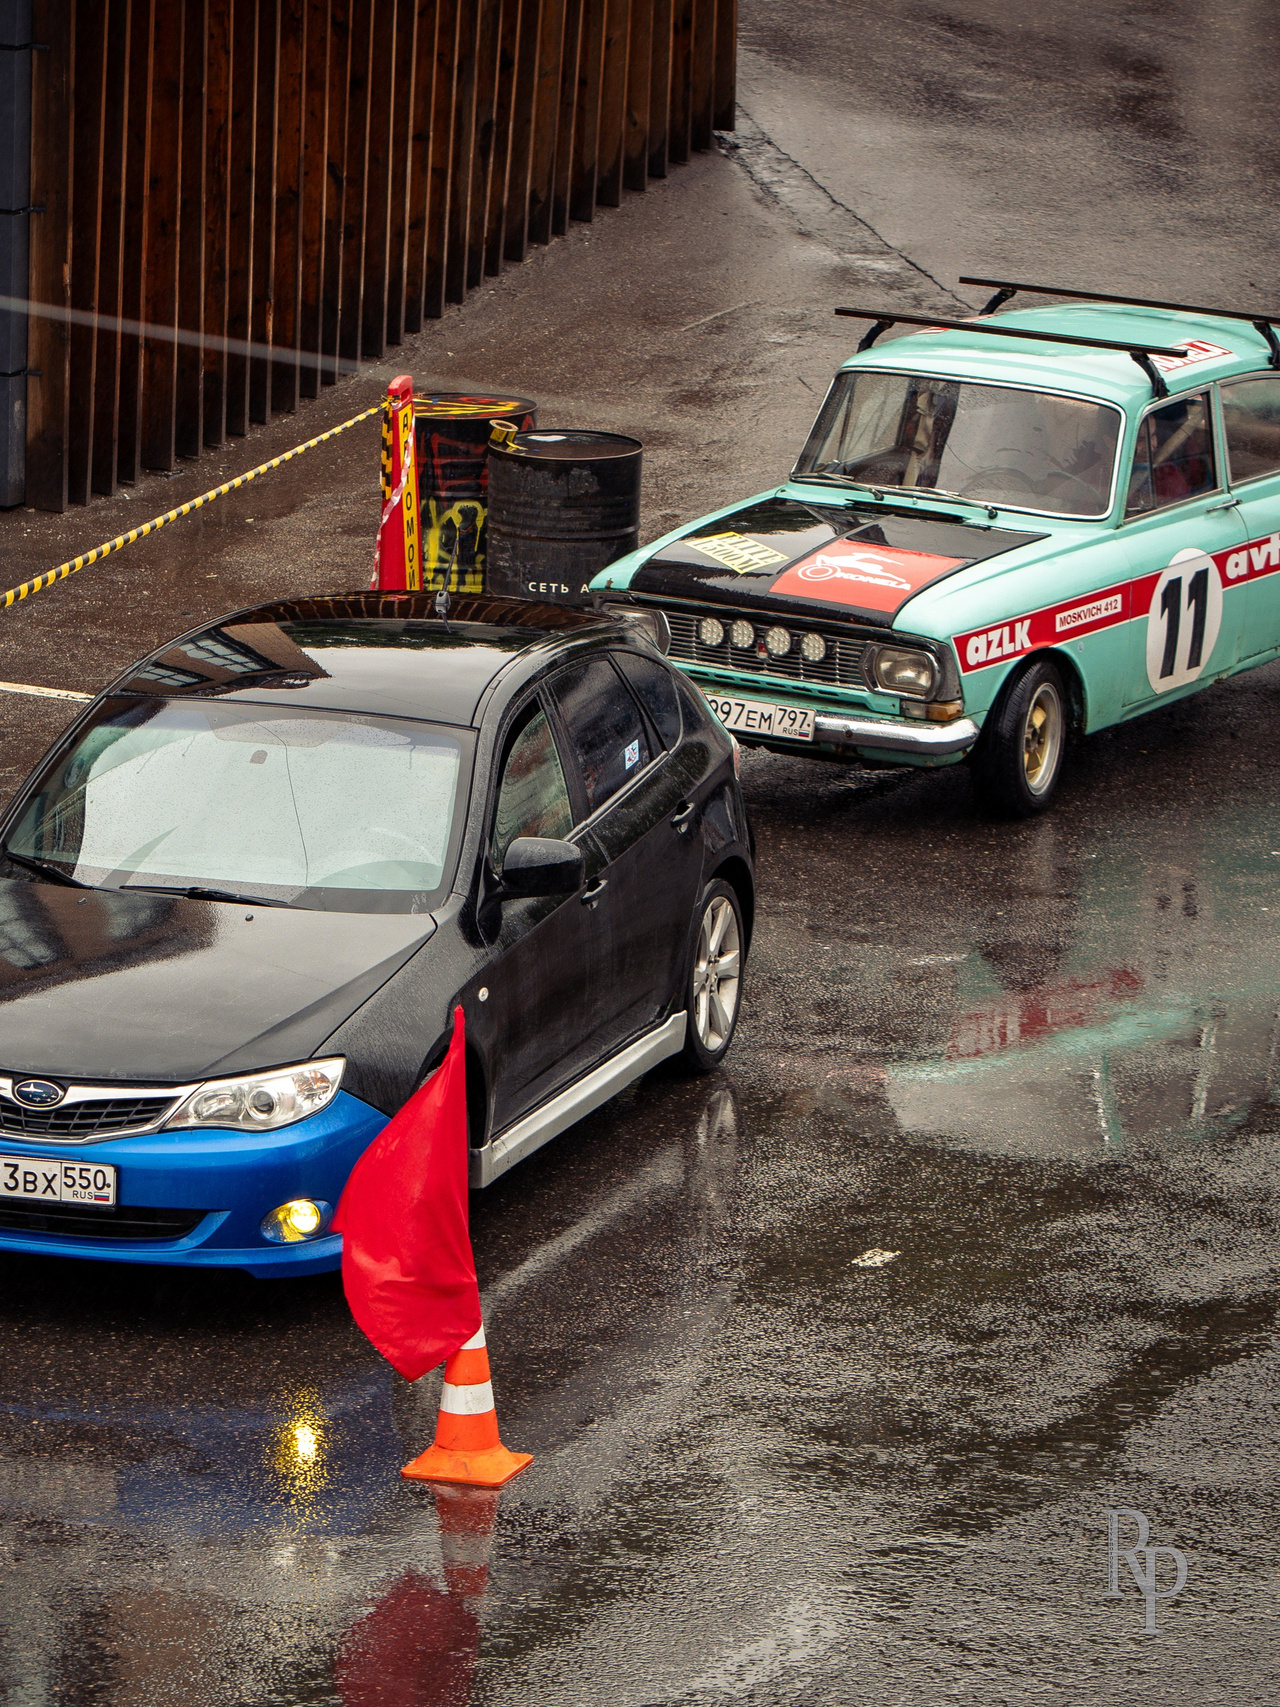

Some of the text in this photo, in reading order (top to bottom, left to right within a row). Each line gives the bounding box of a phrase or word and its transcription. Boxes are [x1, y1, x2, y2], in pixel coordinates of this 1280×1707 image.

[528, 581, 569, 594] СЕТЬ
[1059, 599, 1118, 628] MOSKVICH 412
[1159, 567, 1209, 680] 11
[778, 708, 809, 729] 797
[782, 727, 798, 736] RUS
[63, 1166, 107, 1190] 550
[72, 1190, 93, 1200] RUS
